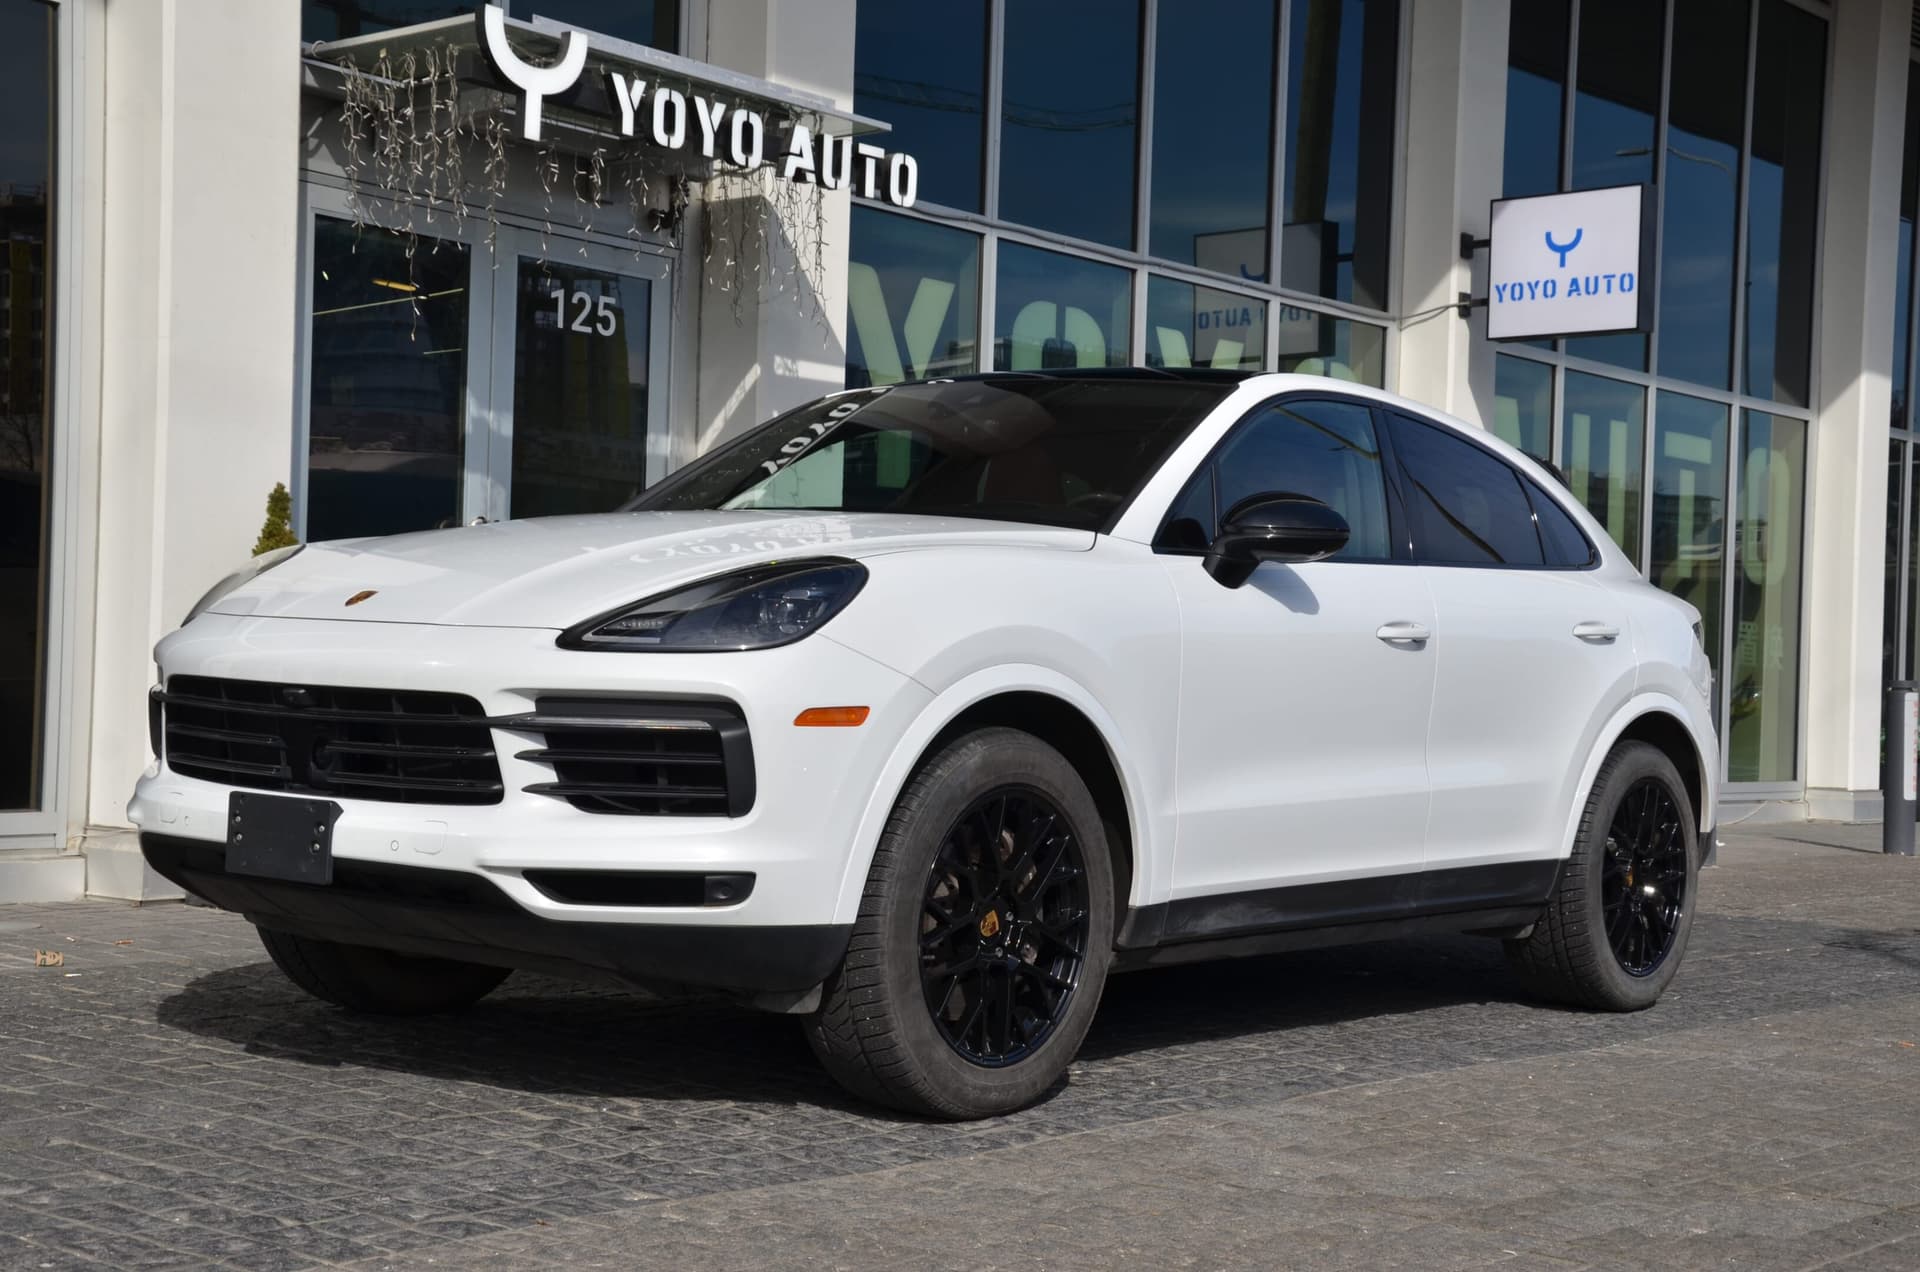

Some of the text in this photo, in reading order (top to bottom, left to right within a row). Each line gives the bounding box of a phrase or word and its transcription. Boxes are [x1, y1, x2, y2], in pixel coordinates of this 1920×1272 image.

[611, 72, 918, 208] YOYO AUTO
[1495, 272, 1635, 303] YOYO AUTO
[551, 288, 617, 337] 125
